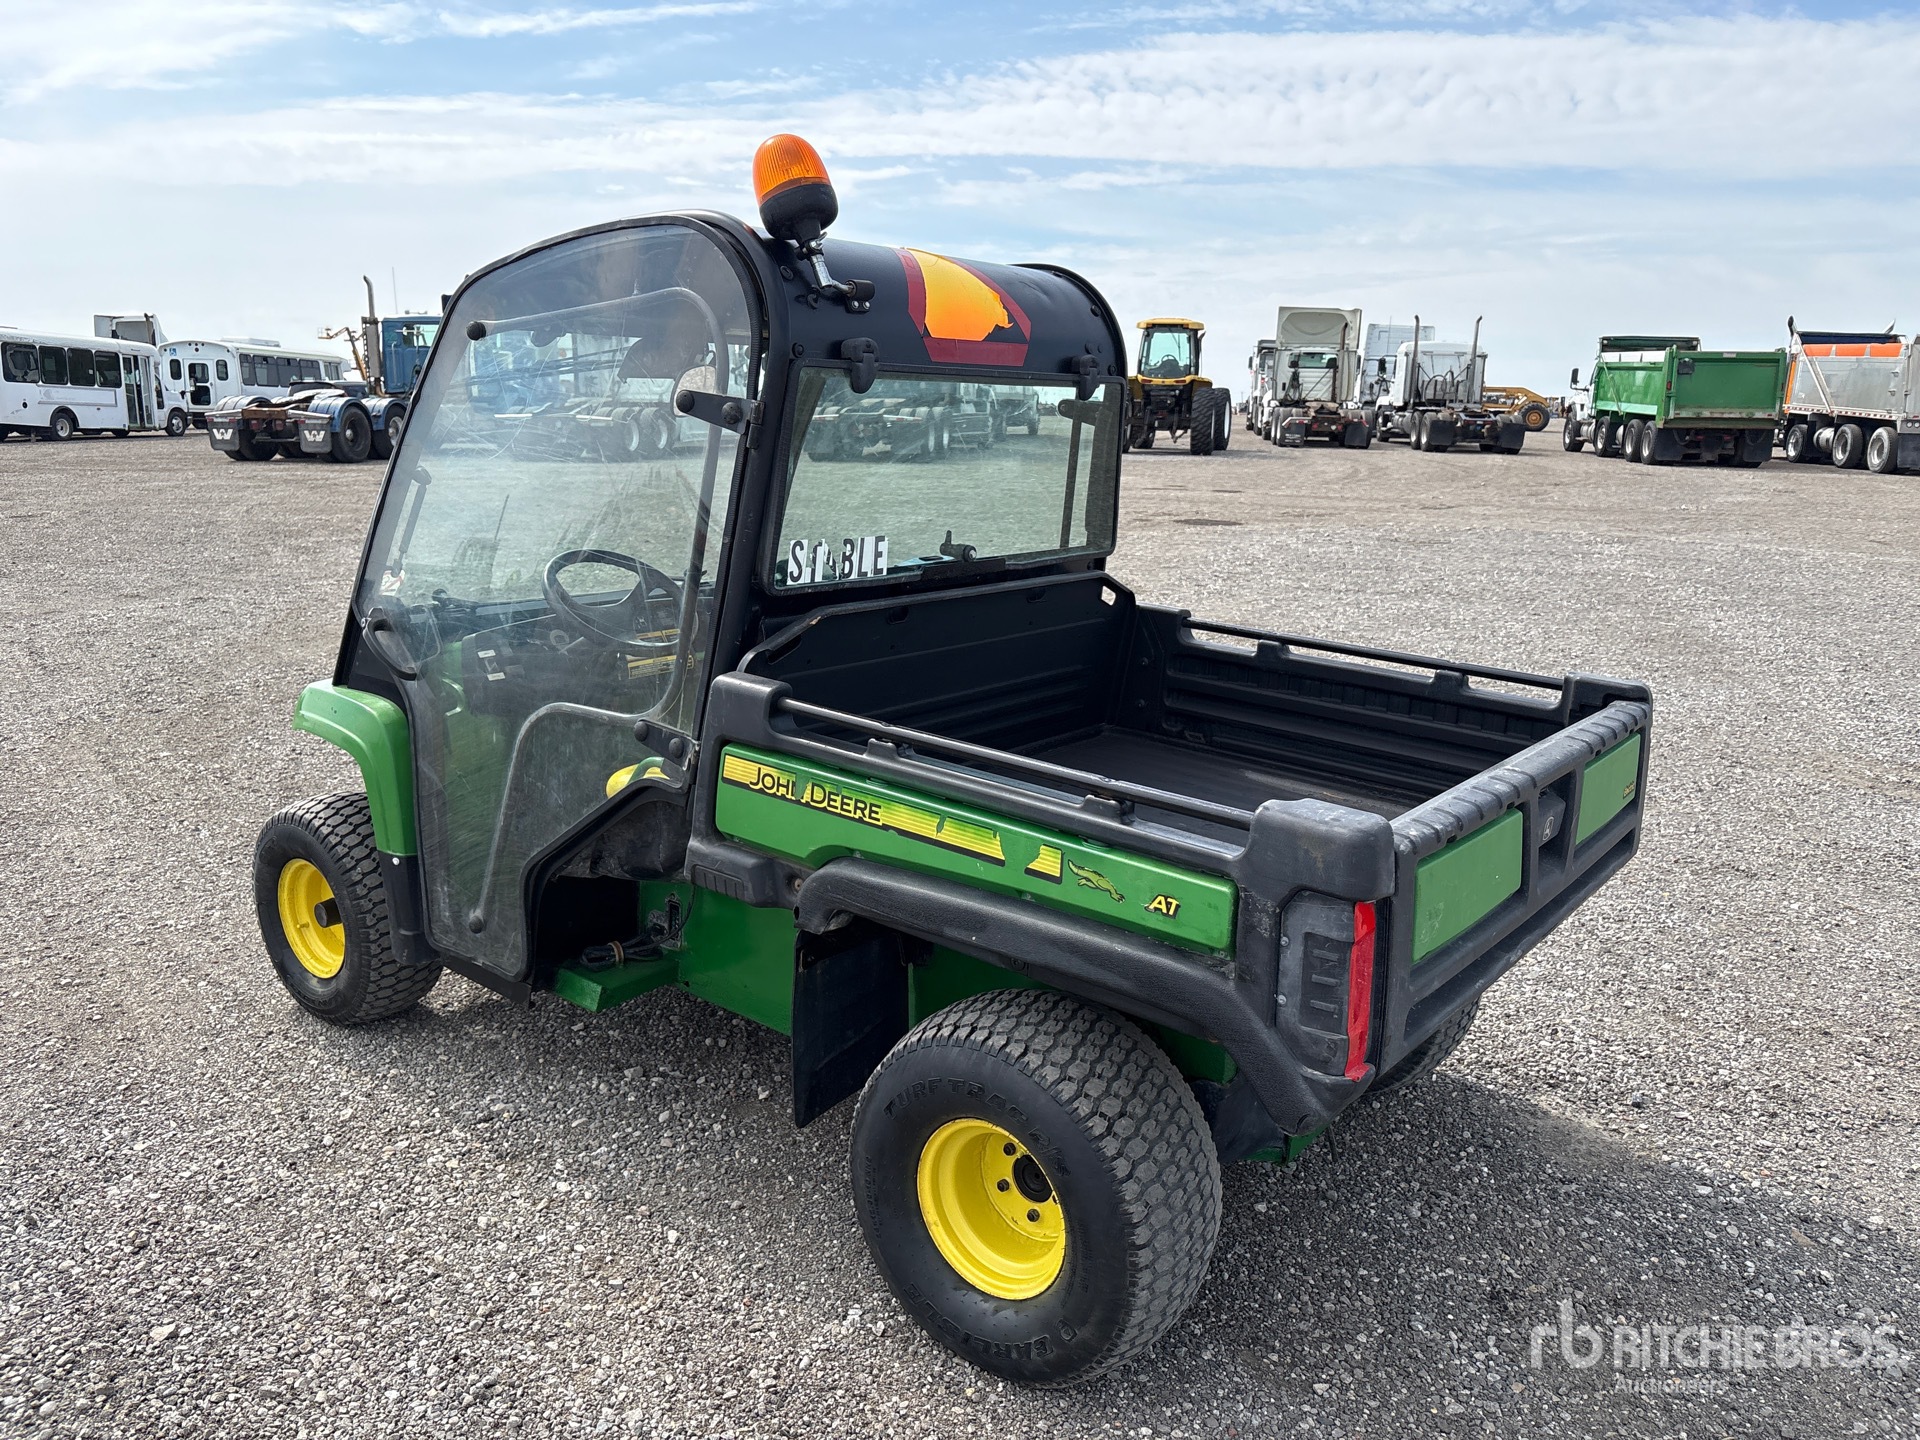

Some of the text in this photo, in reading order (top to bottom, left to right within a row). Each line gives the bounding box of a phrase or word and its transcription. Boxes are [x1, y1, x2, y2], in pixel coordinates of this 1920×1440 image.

[811, 782, 882, 824] DEERE
[883, 1077, 942, 1120] TURF
[948, 1077, 1028, 1125] TRAC
[903, 1283, 1054, 1361] CARLISLE
